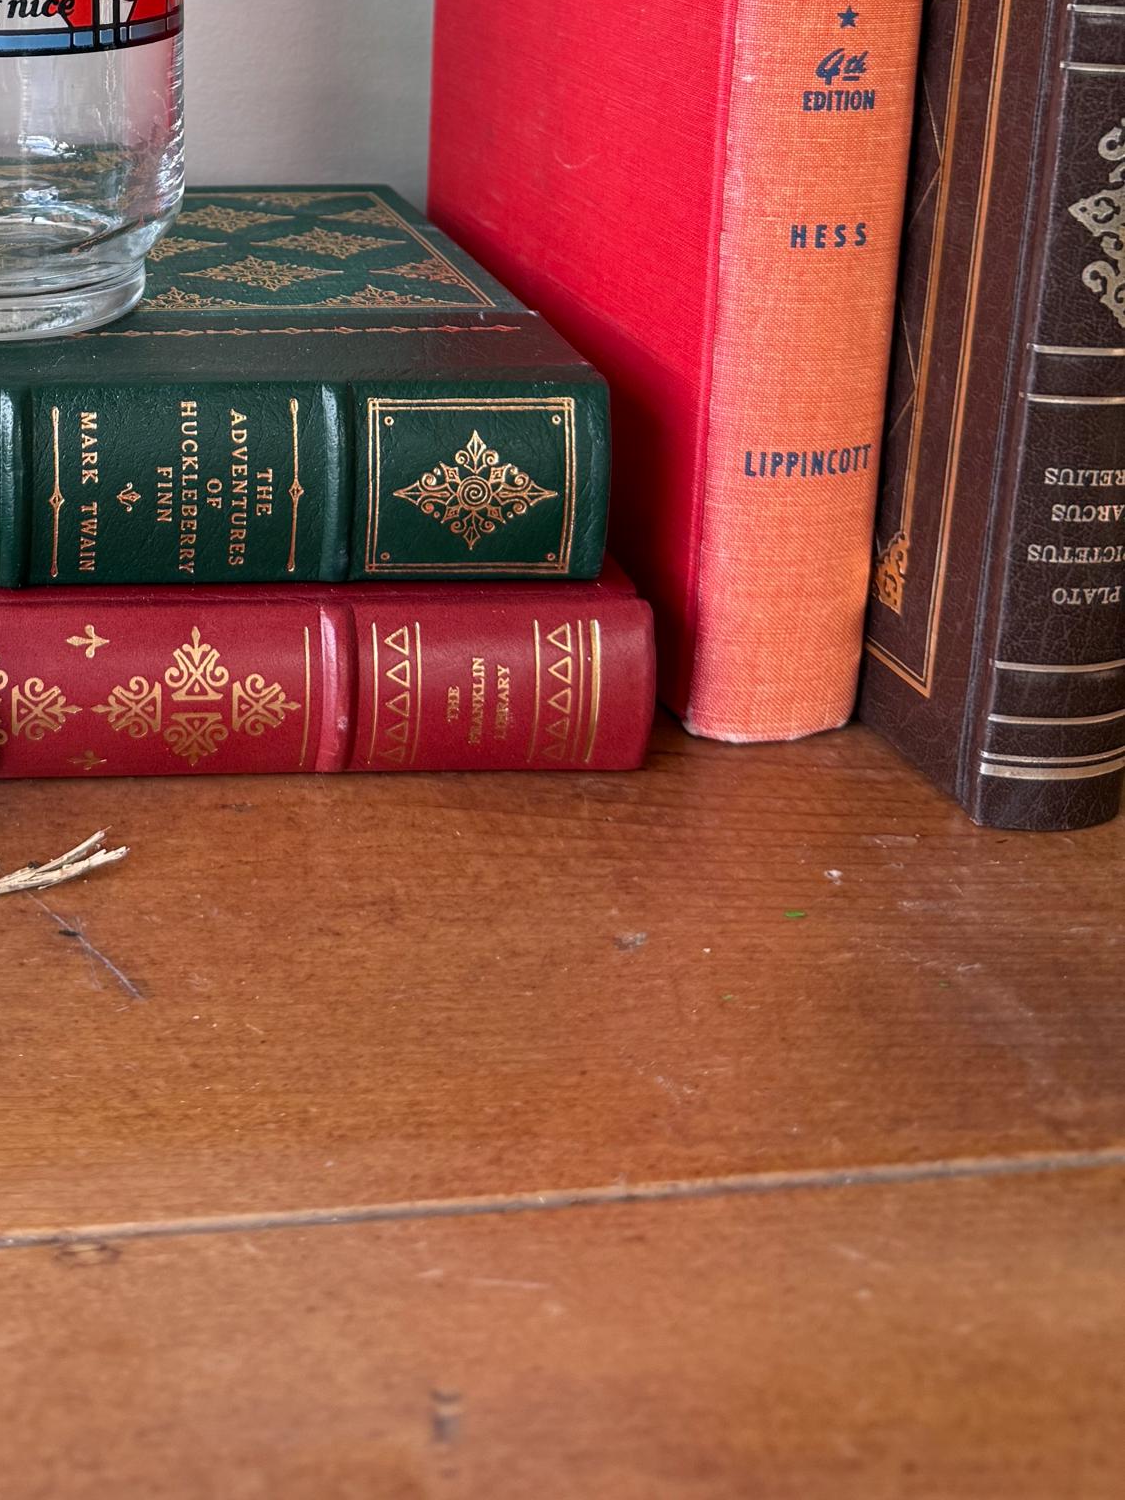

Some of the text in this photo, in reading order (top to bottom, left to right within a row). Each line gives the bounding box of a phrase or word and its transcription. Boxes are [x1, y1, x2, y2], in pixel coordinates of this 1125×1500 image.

[815, 48, 870, 85] 4th
[802, 90, 875, 112] EDITION
[790, 222, 867, 249] HESS
[744, 444, 872, 478] LIPPINCOTT
[1044, 467, 1125, 487] RELIUS
[78, 410, 99, 572] MARK TWAIN
[156, 466, 173, 523] FINN
[178, 400, 199, 574] HUCKLEBERRY
[206, 477, 223, 509] OF
[228, 408, 248, 566] ADVENTURES
[255, 467, 273, 516] THE
[1051, 504, 1125, 522] ARCUS
[1027, 543, 1125, 564] ICTETUS
[1051, 585, 1122, 605] PLATO
[447, 686, 460, 722] THE
